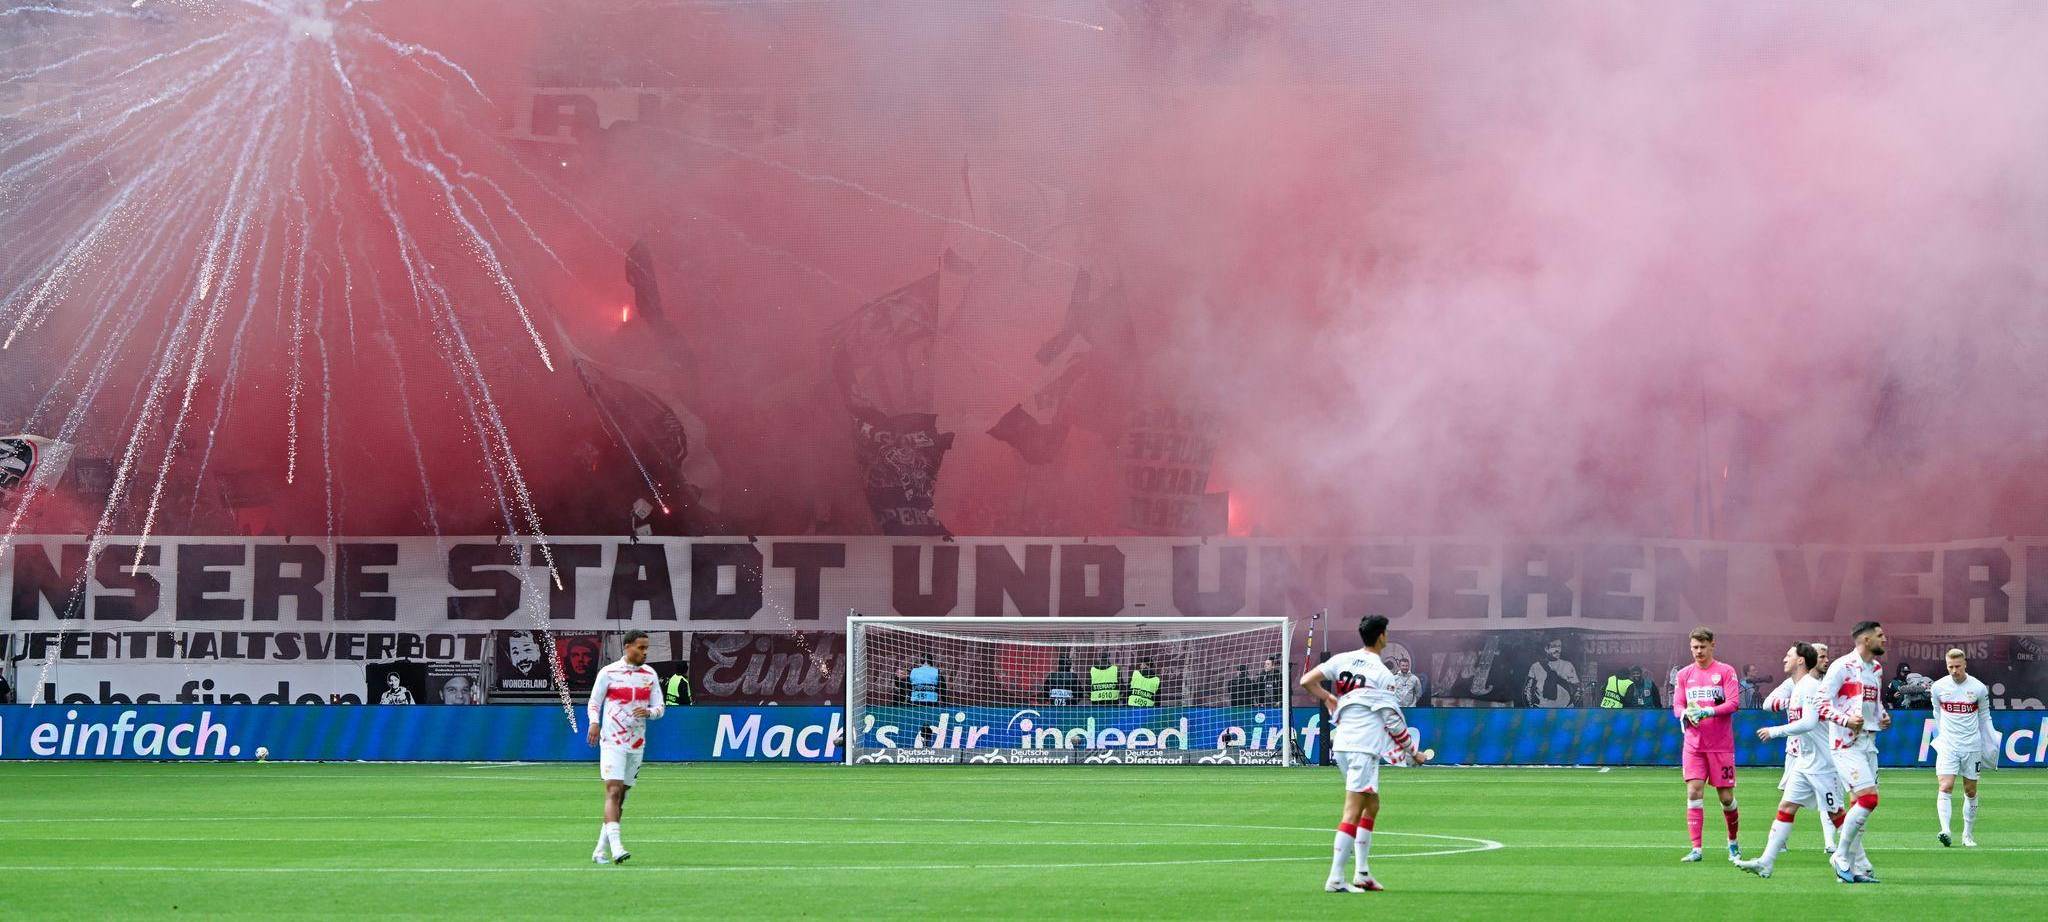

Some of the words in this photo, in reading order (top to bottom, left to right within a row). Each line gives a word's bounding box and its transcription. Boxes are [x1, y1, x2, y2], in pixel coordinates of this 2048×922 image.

[446, 541, 847, 622] STADT
[892, 543, 1126, 618] UND
[1171, 543, 1727, 629] UNSEREN
[1773, 547, 2048, 630] VER
[502, 679, 548, 690] WONDERLAND
[30, 709, 241, 756] einfach.
[897, 755, 955, 764] Dienstrad
[1011, 755, 1069, 764] Dienstrad
[1125, 755, 1183, 764] Dienstrad
[1239, 755, 1297, 764] Dienstrd
[1722, 766, 1734, 780] 33
[1825, 792, 1834, 806] 6
